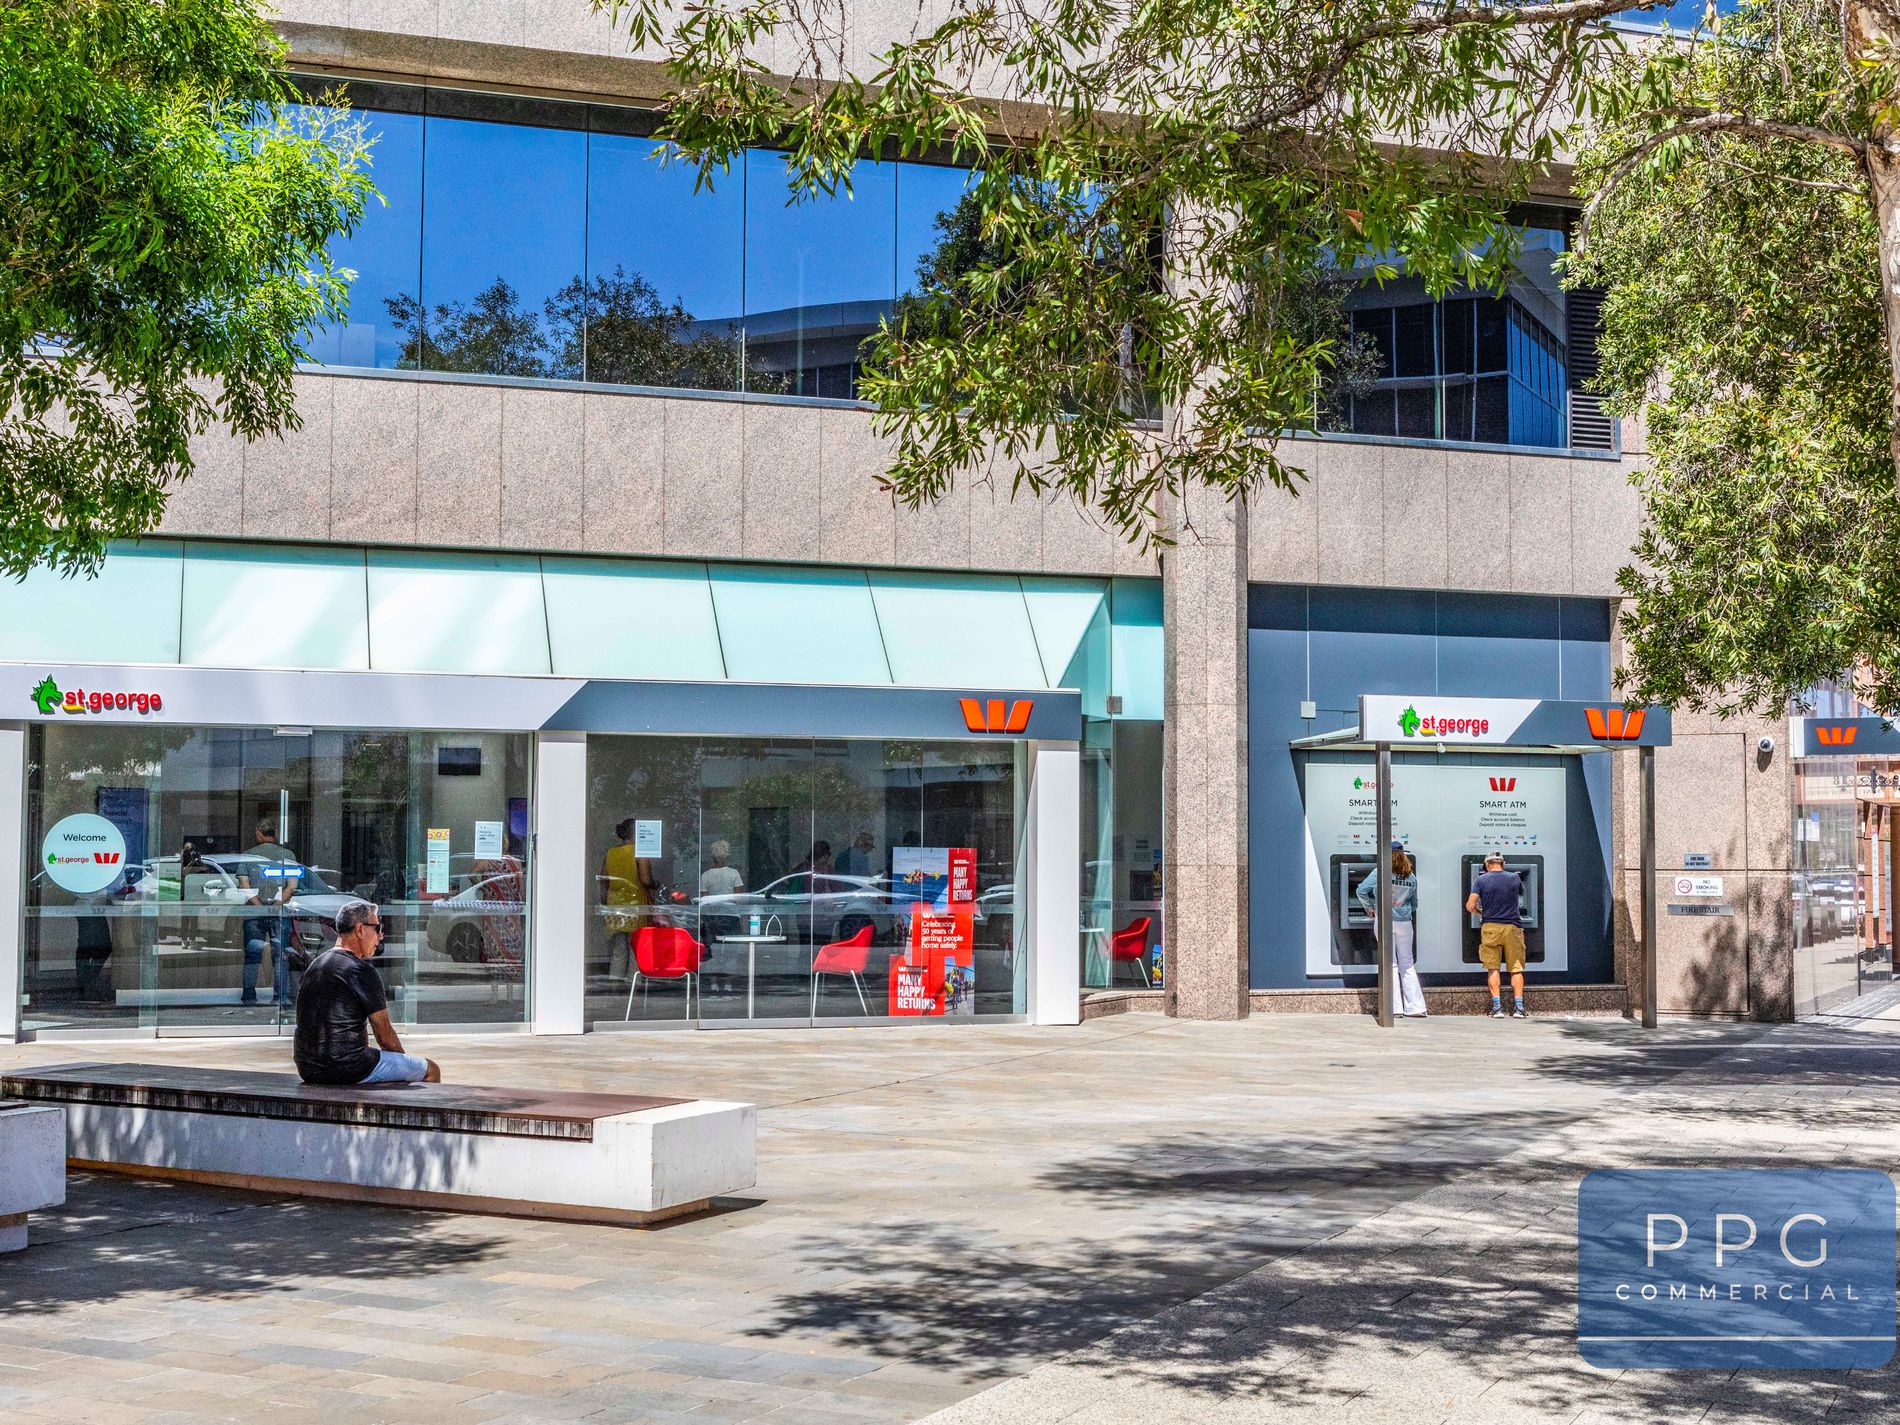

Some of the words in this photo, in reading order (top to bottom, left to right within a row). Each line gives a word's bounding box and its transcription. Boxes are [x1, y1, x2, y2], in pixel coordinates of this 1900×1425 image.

[65, 688, 162, 714] st.george
[1421, 715, 1489, 736] st.george
[1349, 799, 1377, 807] SMART
[1480, 800, 1507, 808] SMART
[63, 833, 107, 841] Welcome
[57, 856, 90, 864] st.george
[1699, 906, 1720, 914] STAIR
[930, 928, 947, 937] years
[921, 935, 943, 943] getting
[943, 935, 964, 943] people
[940, 942, 958, 950] safely.
[898, 974, 921, 986] MANY
[898, 986, 925, 998] HAPPY
[897, 997, 936, 1010] RETURNS
